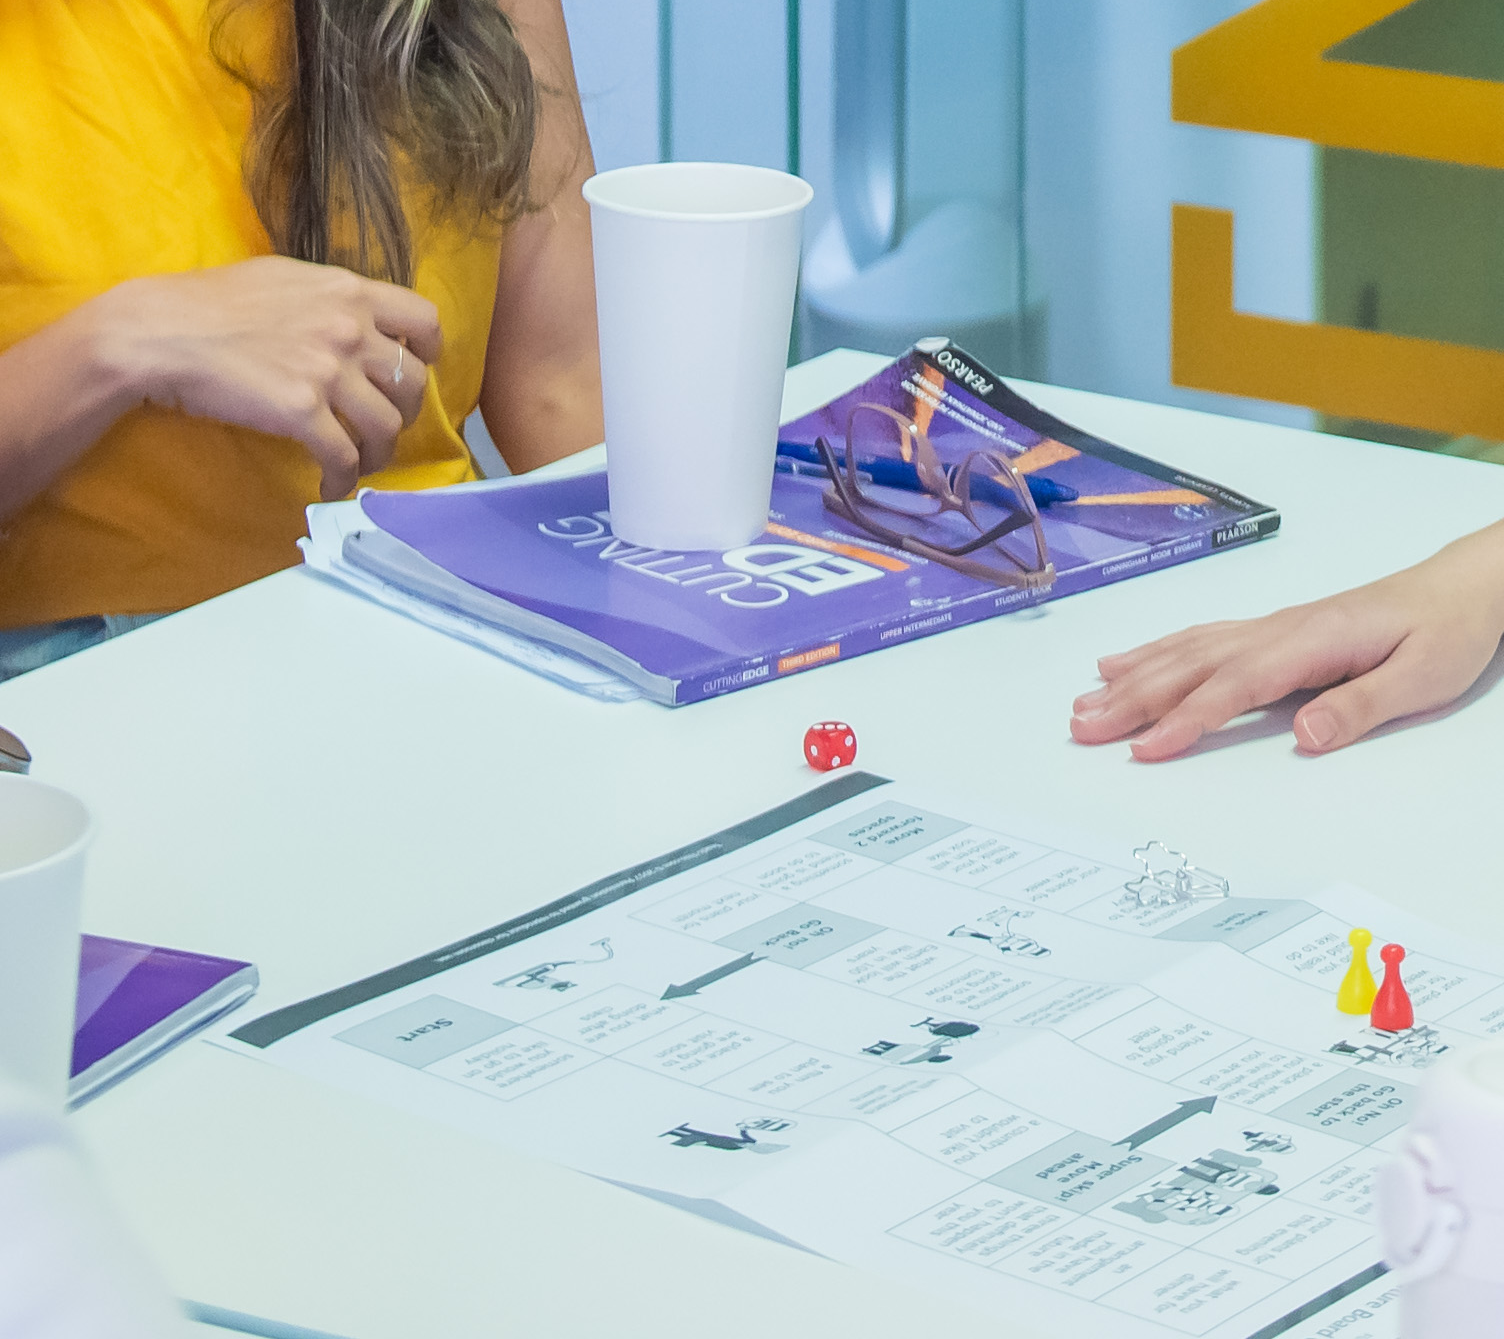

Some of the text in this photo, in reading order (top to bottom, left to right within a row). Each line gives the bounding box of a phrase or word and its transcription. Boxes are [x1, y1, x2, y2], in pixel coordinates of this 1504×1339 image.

[932, 350, 994, 397] PEARSO
[537, 510, 790, 609] CUTTING
[721, 543, 886, 596] ED
[805, 646, 837, 664] EDITION
[880, 625, 903, 641] UPPER
[903, 611, 953, 636] INTERMEDIATE
[1216, 522, 1259, 545] PEARSON
[765, 919, 822, 947] Go Back
[783, 926, 834, 951] Oh no!
[1285, 932, 1340, 961] like to do
[396, 1018, 454, 1042] Start
[1125, 1023, 1197, 1061] are going to
[1127, 1025, 1162, 1045] meet
[1165, 1035, 1206, 1057] friend
[496, 1053, 575, 1089] somewhere
[1142, 1053, 1169, 1068] you
[1198, 1050, 1266, 1087] you are old
[1214, 1054, 1288, 1092] to live when
[1224, 1055, 1305, 1101] you would like
[1280, 1066, 1314, 1085] place
[1242, 1085, 1282, 1105] where
[1306, 1083, 1372, 1118] the start
[1320, 1085, 1396, 1127] Go back to
[1355, 1097, 1404, 1126] Oh No!
[939, 1114, 990, 1140] to visit
[939, 1114, 1021, 1156] wouldn't like
[952, 1119, 1041, 1166] a country you
[1035, 1152, 1085, 1180] ahead
[1054, 1154, 1143, 1203] Super skip!
[1056, 1160, 1104, 1183] Move
[1319, 1165, 1356, 1186] years
[929, 1199, 1004, 1237] to you this
[934, 1202, 966, 1221] year
[939, 1200, 1028, 1248] won't happen
[955, 1205, 1049, 1255] that definitely
[978, 1214, 1061, 1257] three things
[1028, 1234, 1075, 1258] future
[1234, 1214, 1317, 1256] this evening
[1253, 1216, 1337, 1266] your plans for
[1028, 1230, 1109, 1274] made in the
[1054, 1240, 1117, 1274] you have
[1061, 1240, 1147, 1287] arrangement
[1153, 1273, 1195, 1298] dinner
[1153, 1269, 1232, 1314] will have for
[1179, 1280, 1241, 1314] what you
[1315, 1308, 1375, 1339] Board
